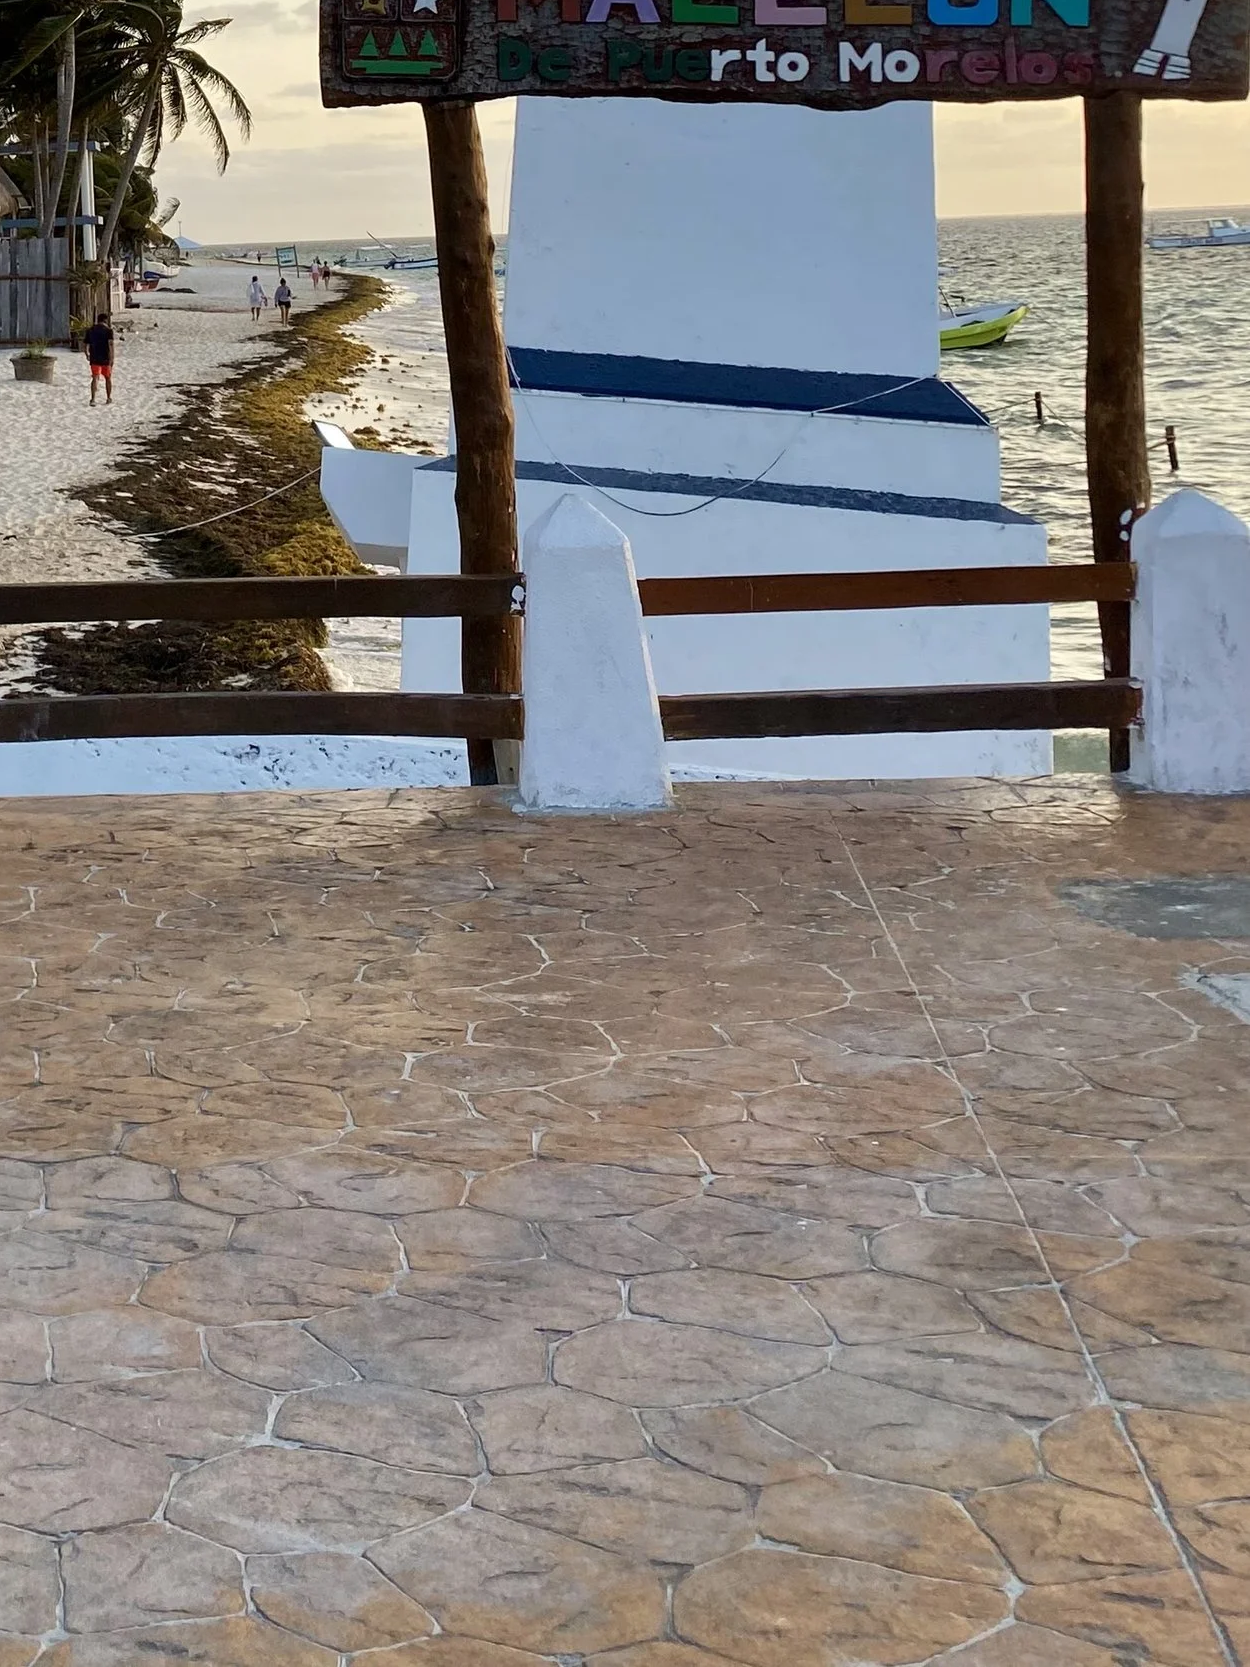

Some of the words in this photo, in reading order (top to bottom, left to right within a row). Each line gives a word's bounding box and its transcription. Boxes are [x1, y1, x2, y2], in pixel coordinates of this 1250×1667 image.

[497, 38, 572, 82] De
[607, 37, 810, 83] Puerto
[839, 41, 1095, 85] Morelos
